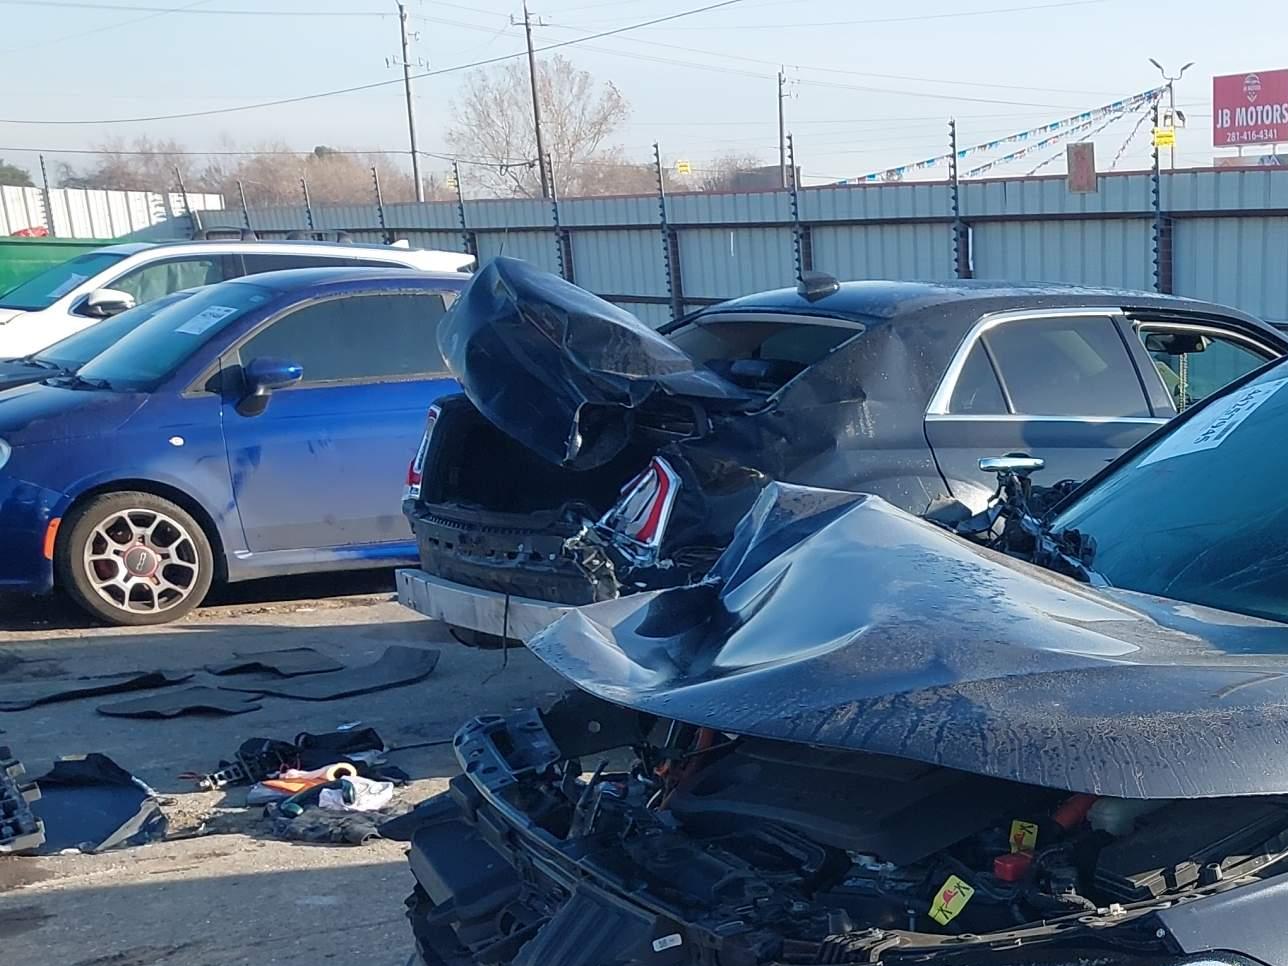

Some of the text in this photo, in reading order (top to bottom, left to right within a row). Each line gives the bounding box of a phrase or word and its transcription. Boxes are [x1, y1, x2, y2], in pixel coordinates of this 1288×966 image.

[1216, 103, 1288, 129] JB MOTORS
[1226, 128, 1278, 142] 281-416-4341
